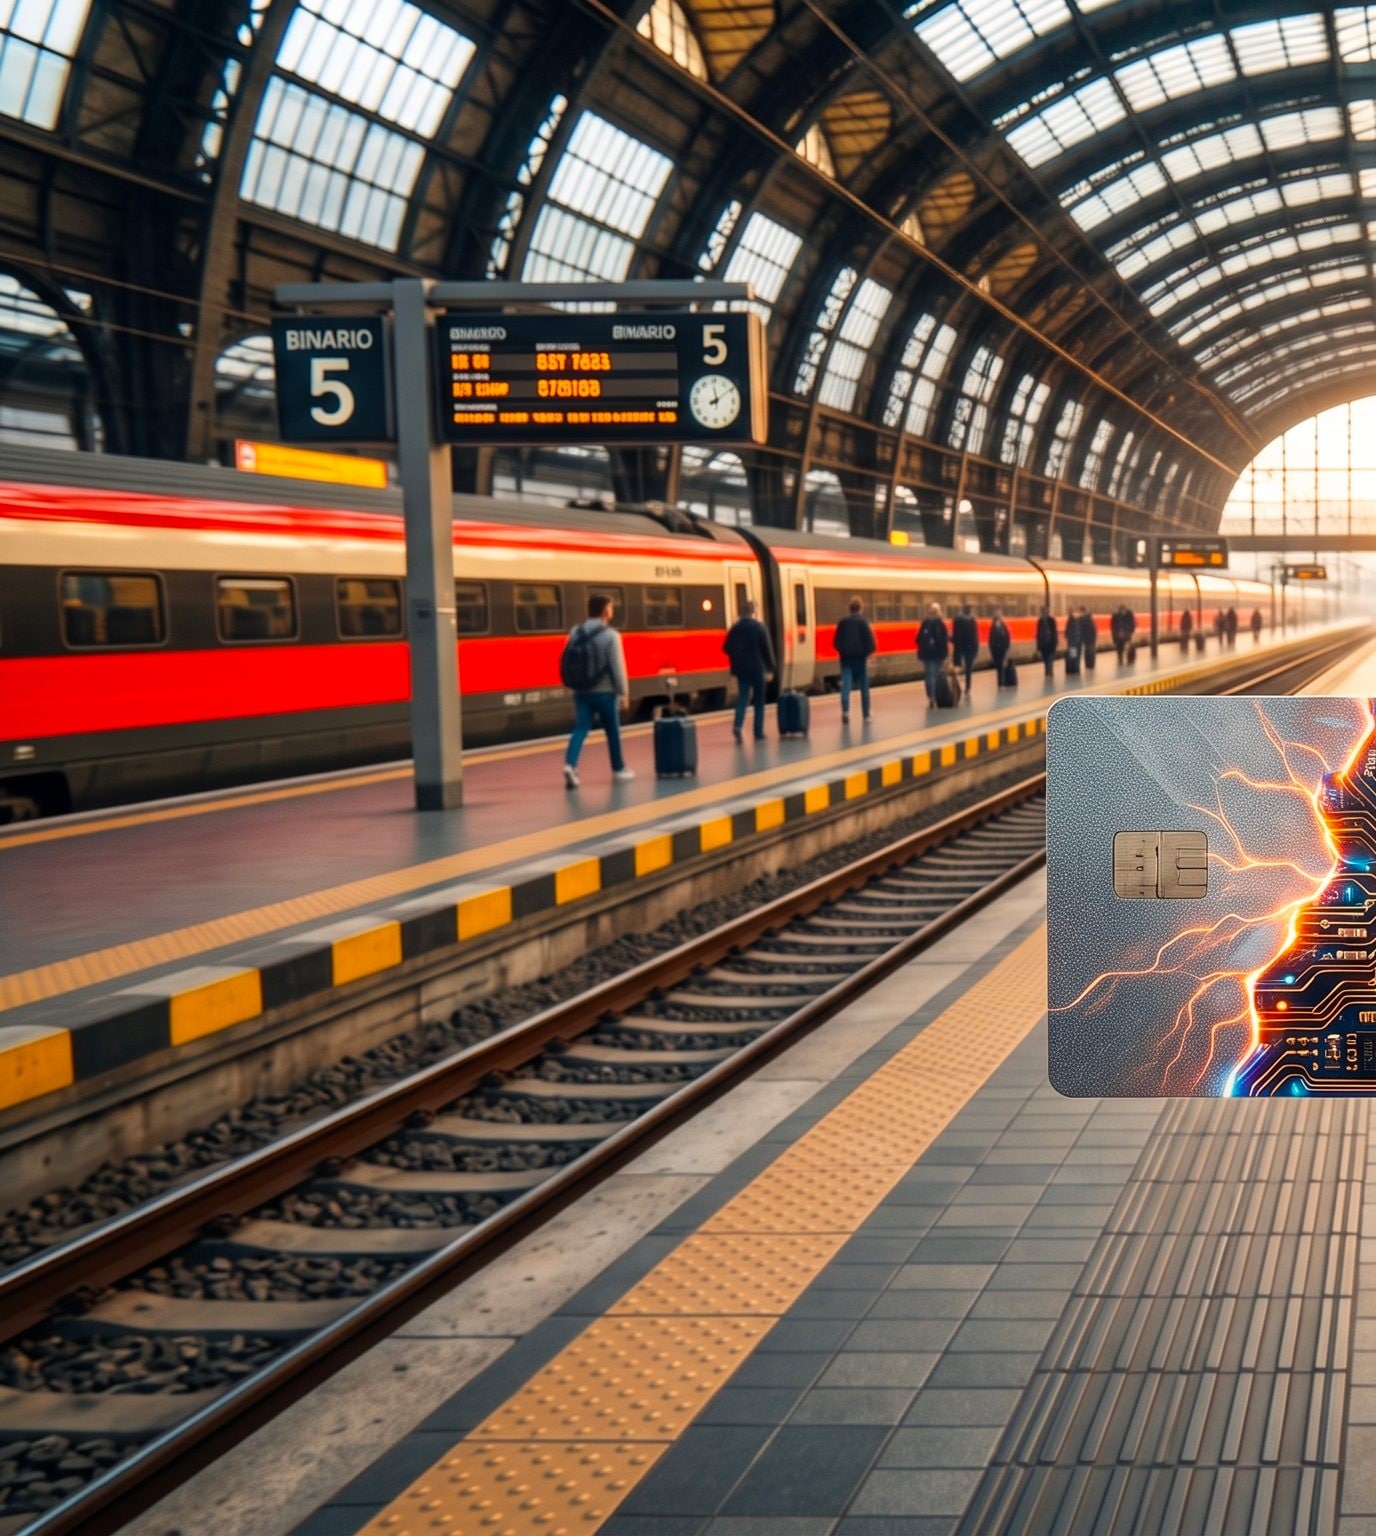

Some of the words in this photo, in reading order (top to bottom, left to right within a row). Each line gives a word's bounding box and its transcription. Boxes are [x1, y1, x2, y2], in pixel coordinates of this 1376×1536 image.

[286, 328, 374, 351] BINARIO
[702, 324, 728, 366] 5
[310, 357, 355, 427] 5
